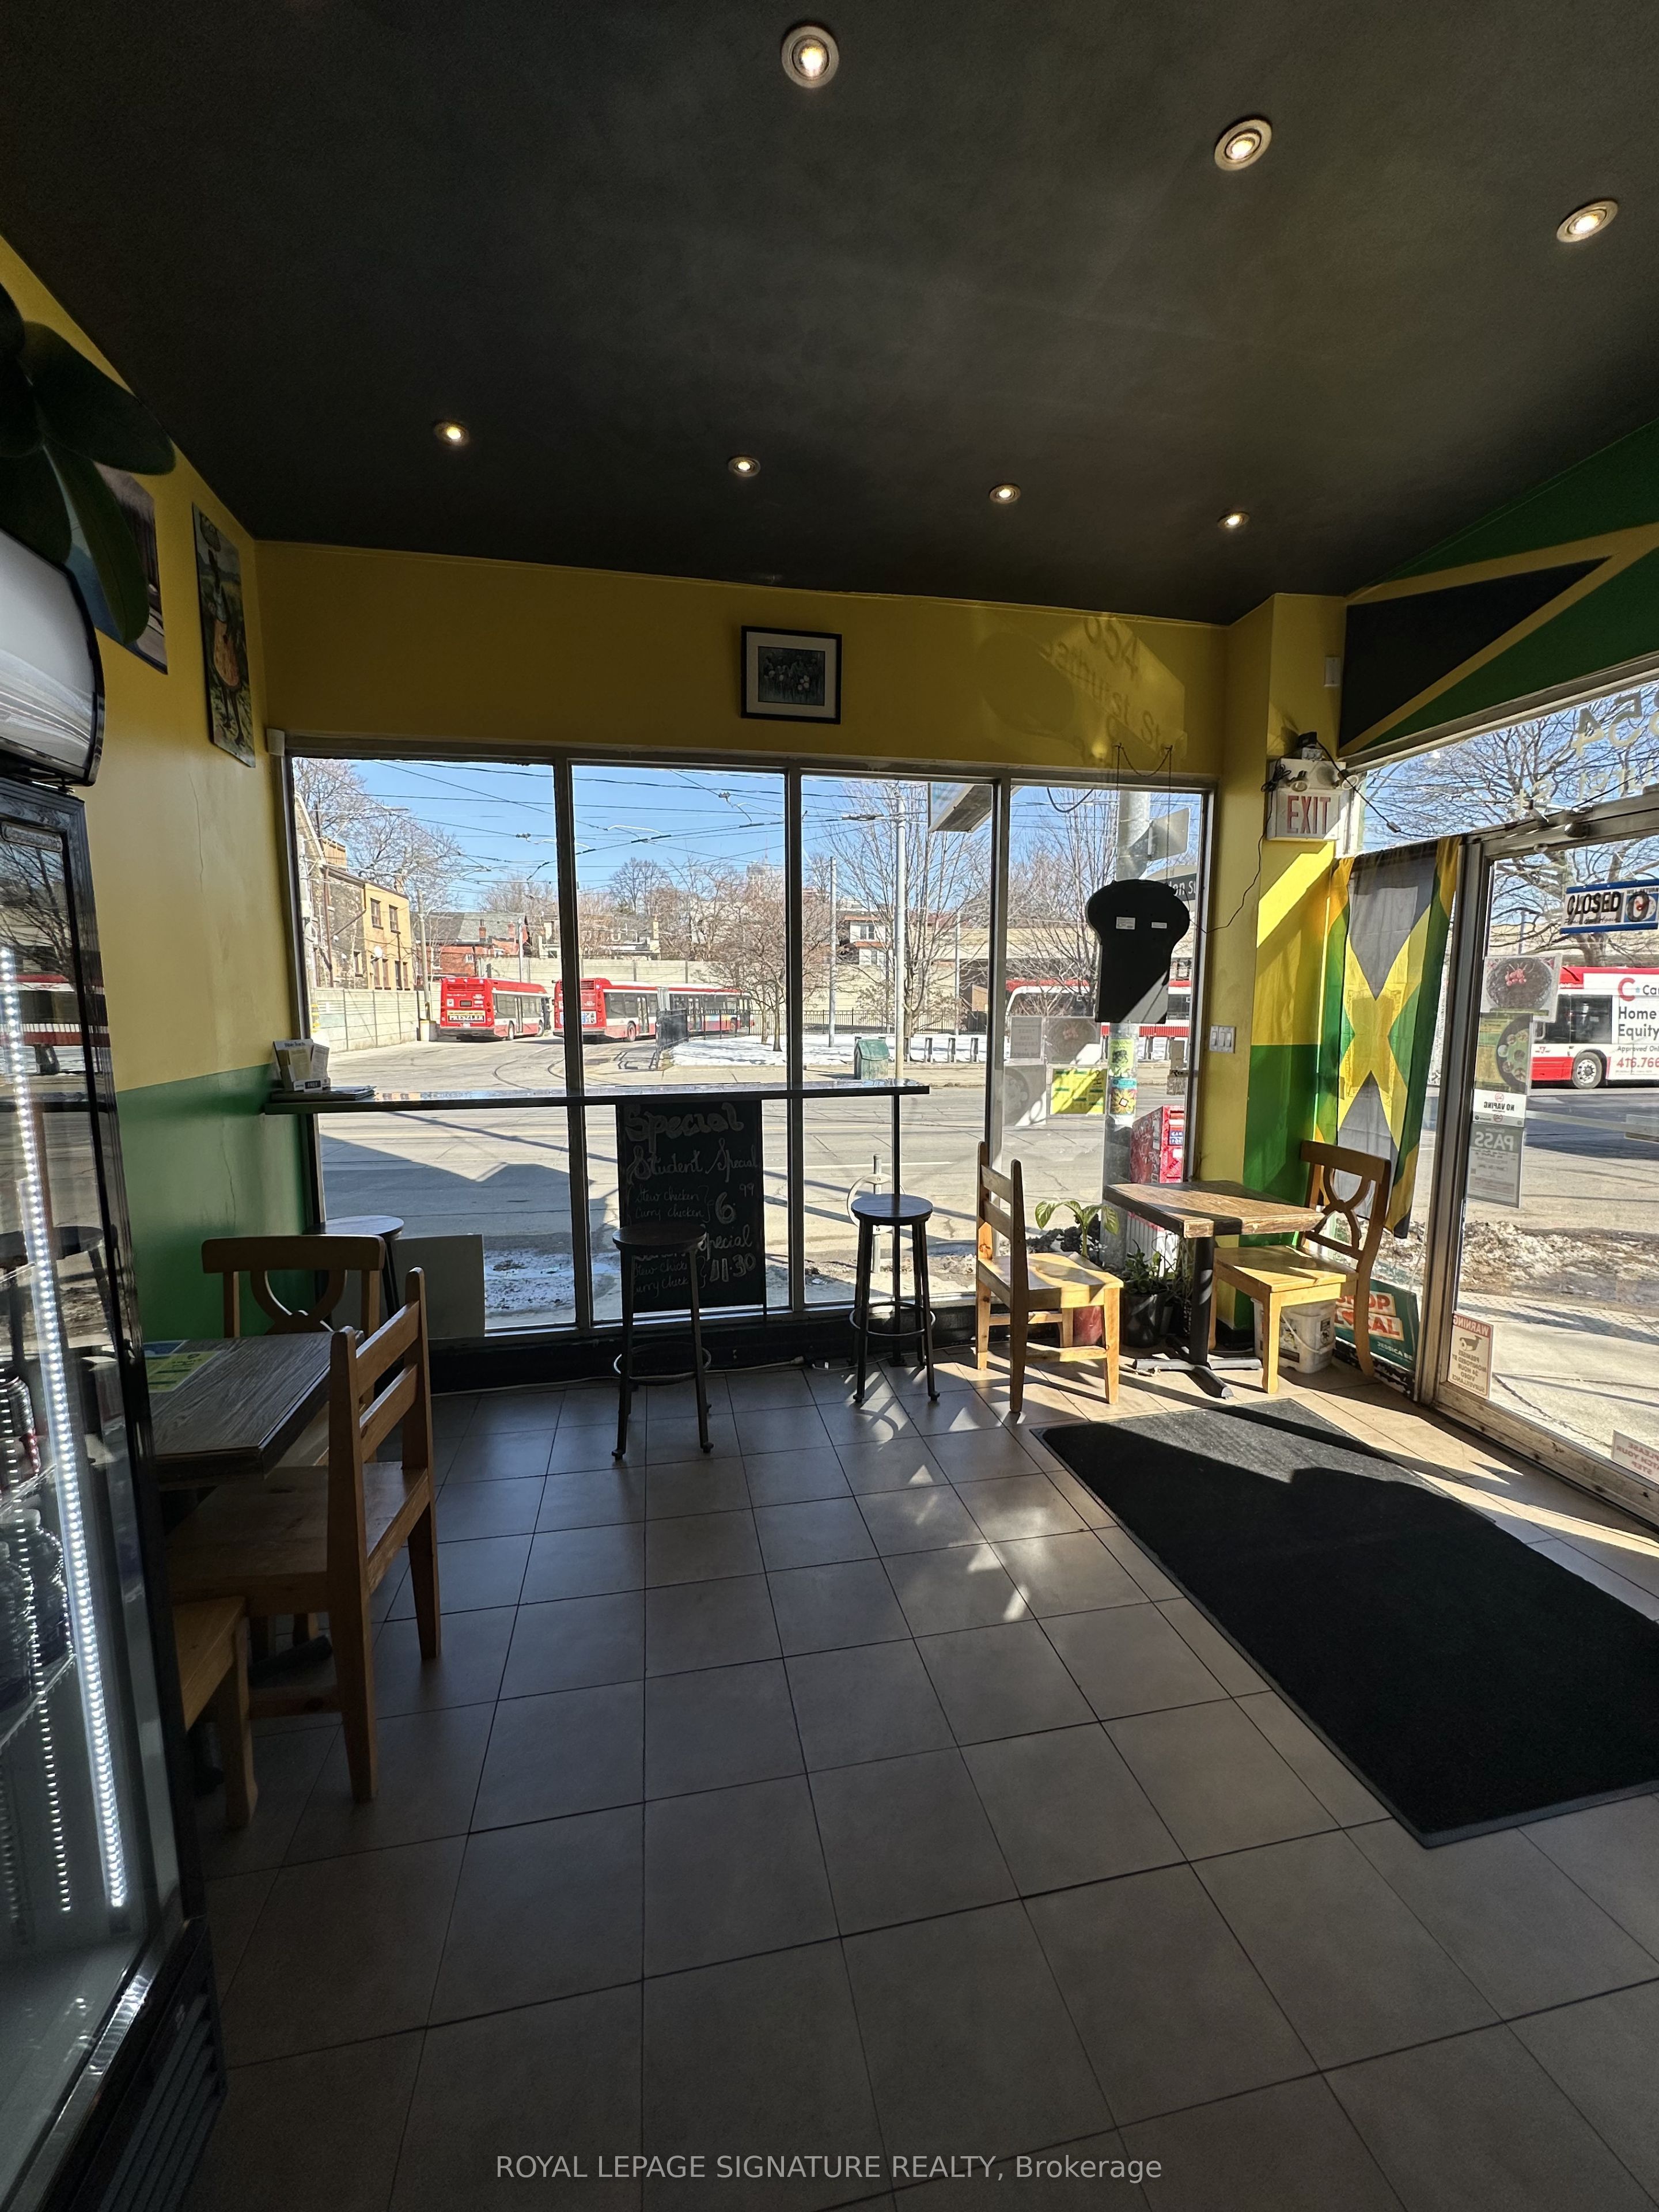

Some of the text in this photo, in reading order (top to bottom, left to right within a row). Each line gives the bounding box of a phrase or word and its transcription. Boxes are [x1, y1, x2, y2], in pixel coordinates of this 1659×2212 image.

[1287, 795, 1331, 835] EXIT
[1567, 891, 1622, 915] CLOSED
[1642, 984, 1659, 995] Ca
[1619, 1006, 1657, 1020] Home
[1618, 1023, 1659, 1041] Equity
[1618, 1046, 1648, 1054] Approved
[624, 1102, 744, 1153] Special
[626, 1138, 759, 1185] Student Special
[635, 1282, 660, 1297] urry
[1377, 1341, 1403, 1357] JESSICA
